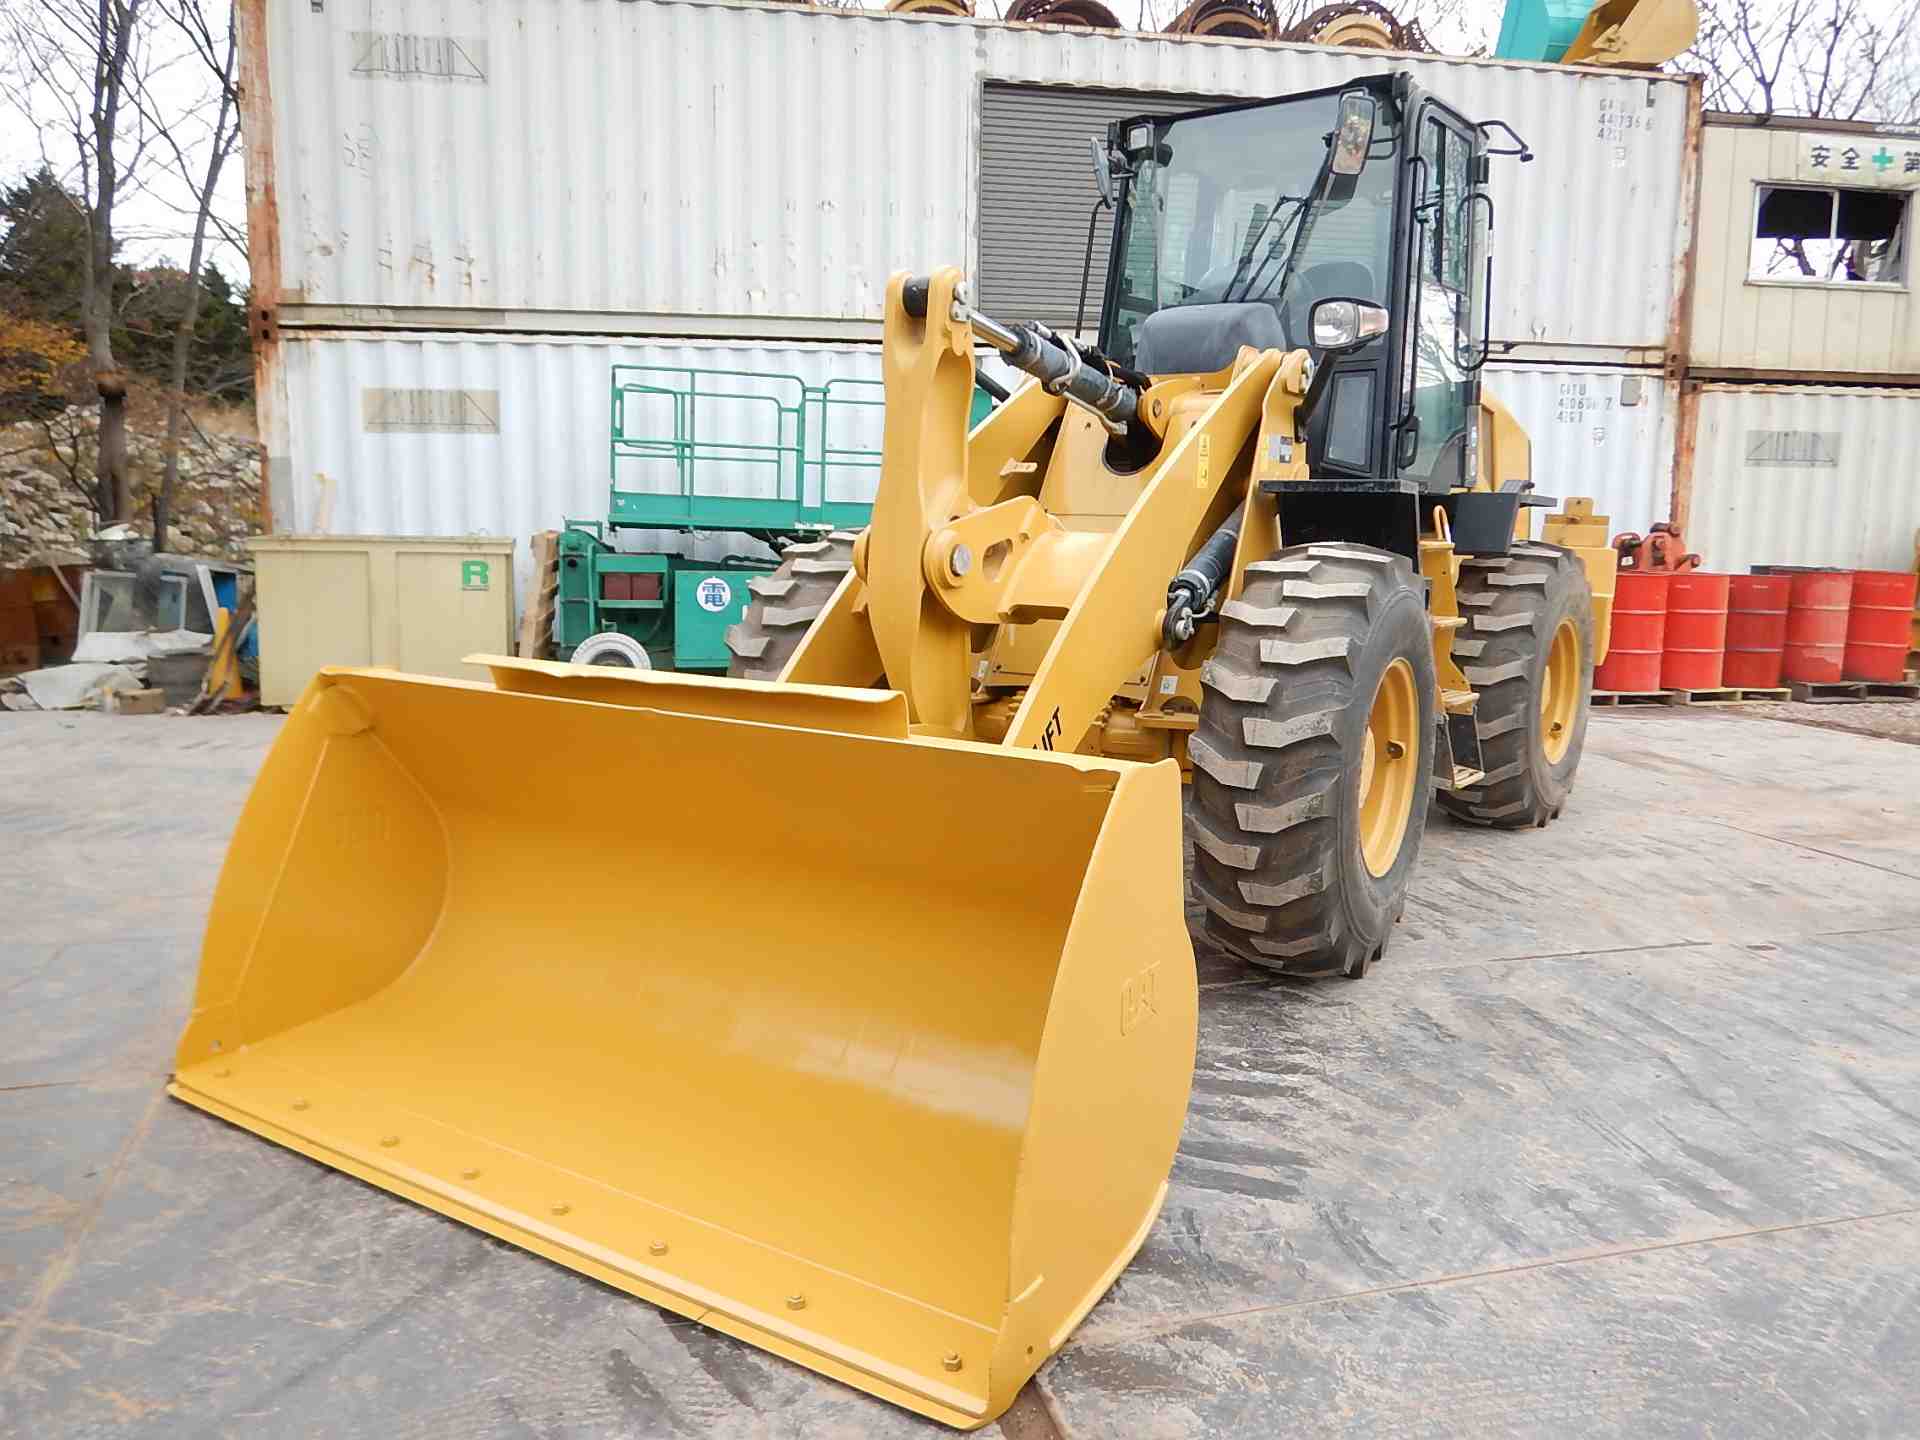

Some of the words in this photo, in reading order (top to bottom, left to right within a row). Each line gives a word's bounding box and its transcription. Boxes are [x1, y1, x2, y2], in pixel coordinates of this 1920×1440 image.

[1811, 145, 1860, 169] 安全
[463, 560, 489, 585] R
[702, 582, 726, 607] 電
[1032, 705, 1061, 751] IFT
